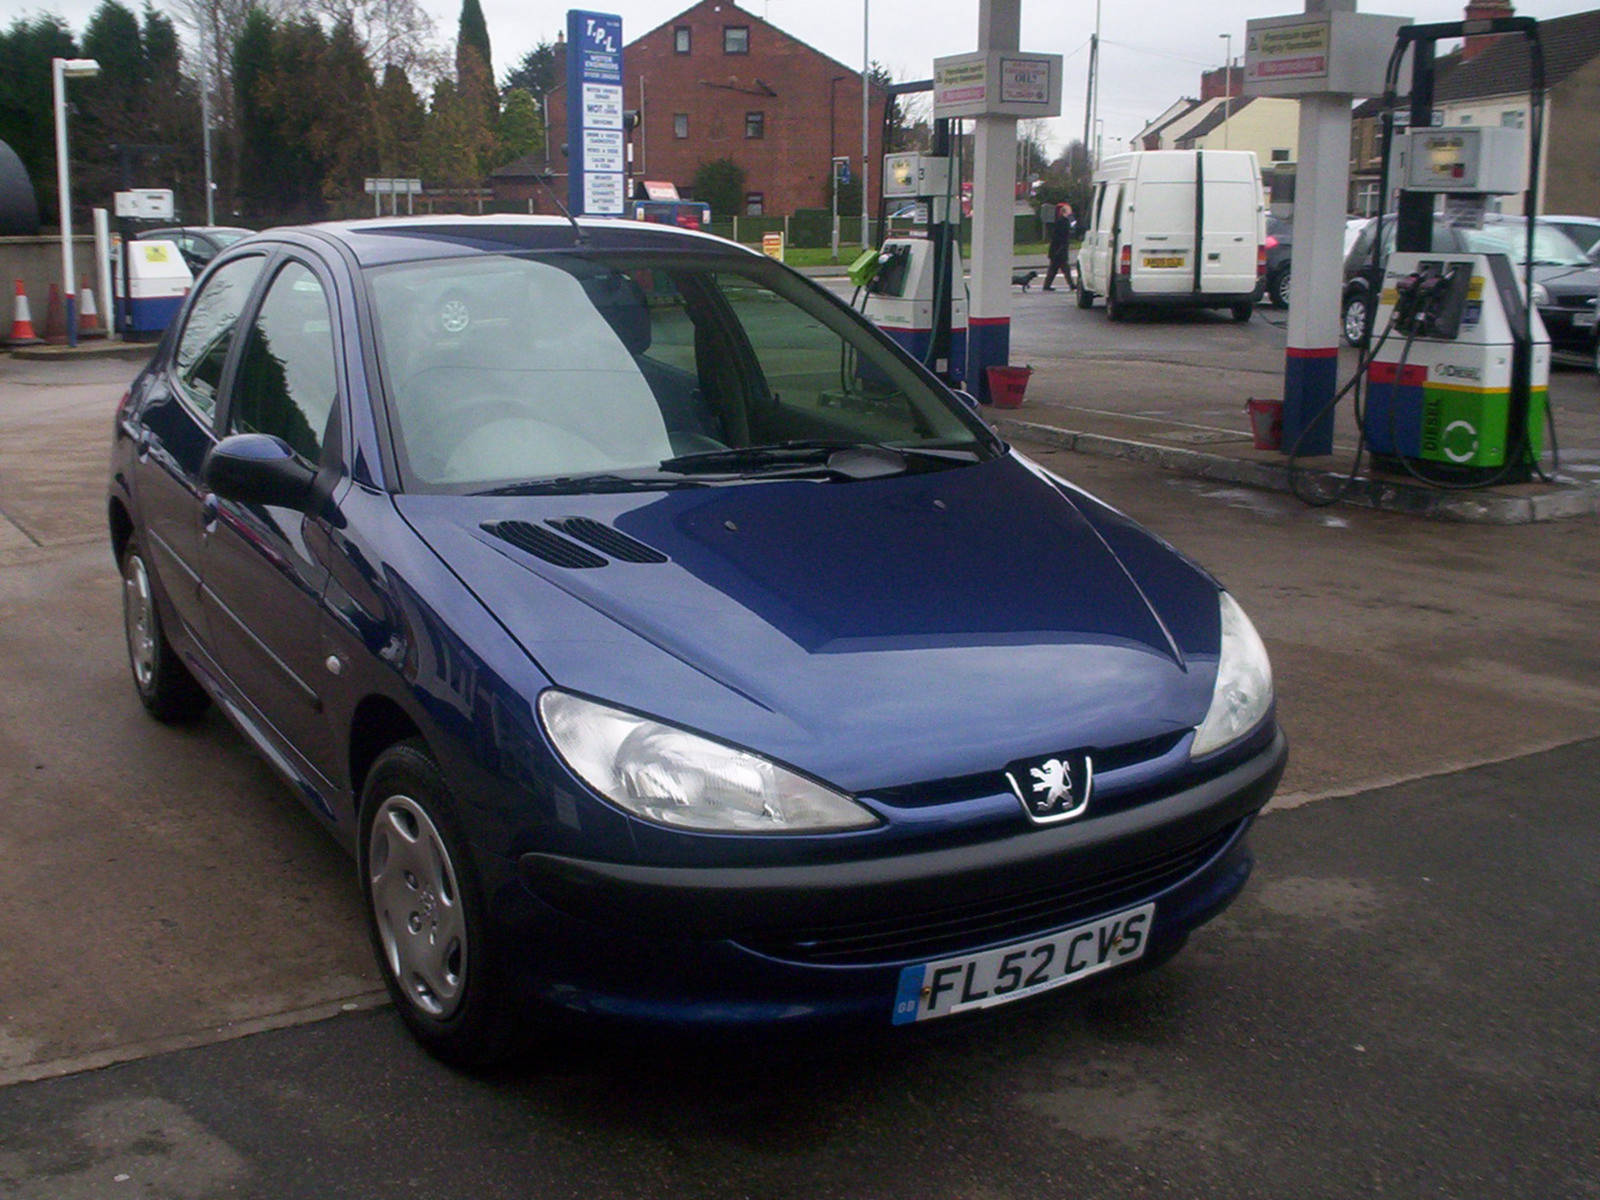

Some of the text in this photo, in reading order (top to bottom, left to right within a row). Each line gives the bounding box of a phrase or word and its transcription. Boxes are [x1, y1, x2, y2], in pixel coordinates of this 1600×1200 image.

[926, 943, 1056, 1011] FL52
[1063, 913, 1147, 975] CVS
[897, 1000, 916, 1014] GB
